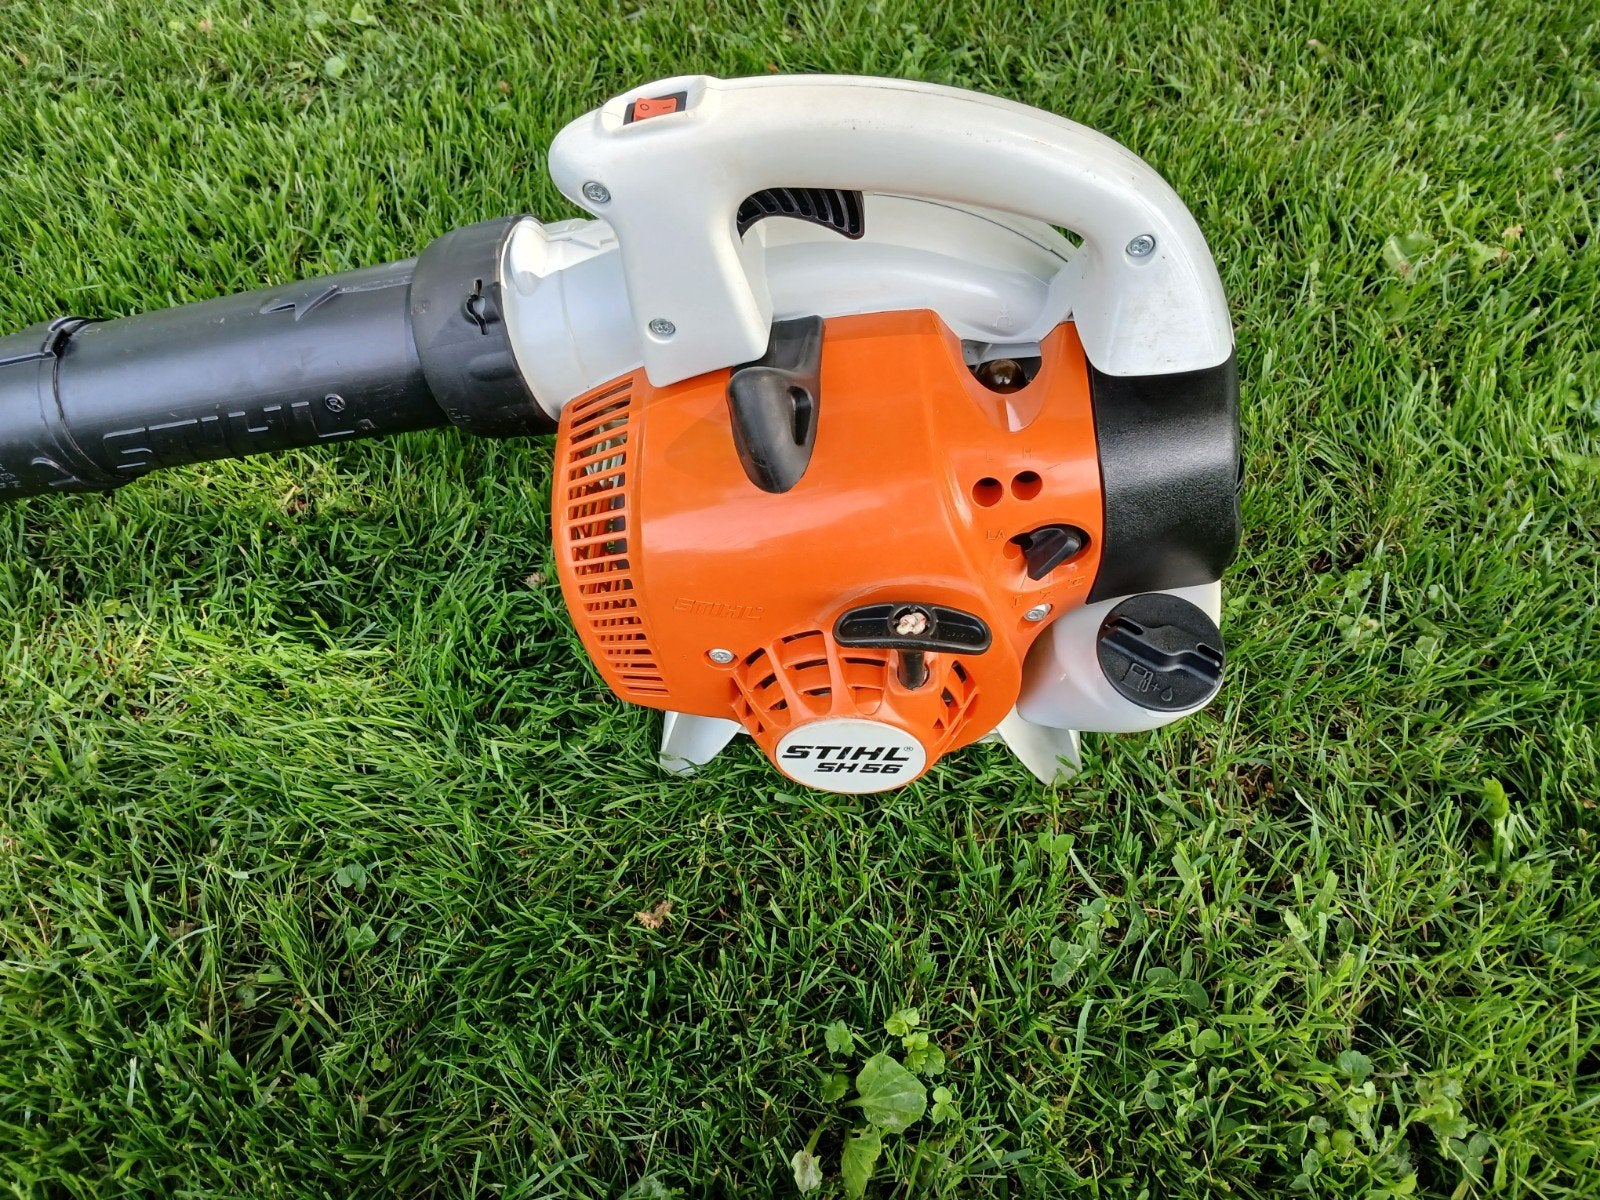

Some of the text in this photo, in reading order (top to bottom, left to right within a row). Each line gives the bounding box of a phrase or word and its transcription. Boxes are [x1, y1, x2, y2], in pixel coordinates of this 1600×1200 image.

[986, 529, 1006, 540] LA
[672, 597, 762, 620] STIHL
[781, 745, 910, 762] STIHL
[815, 762, 904, 774] SH 56
